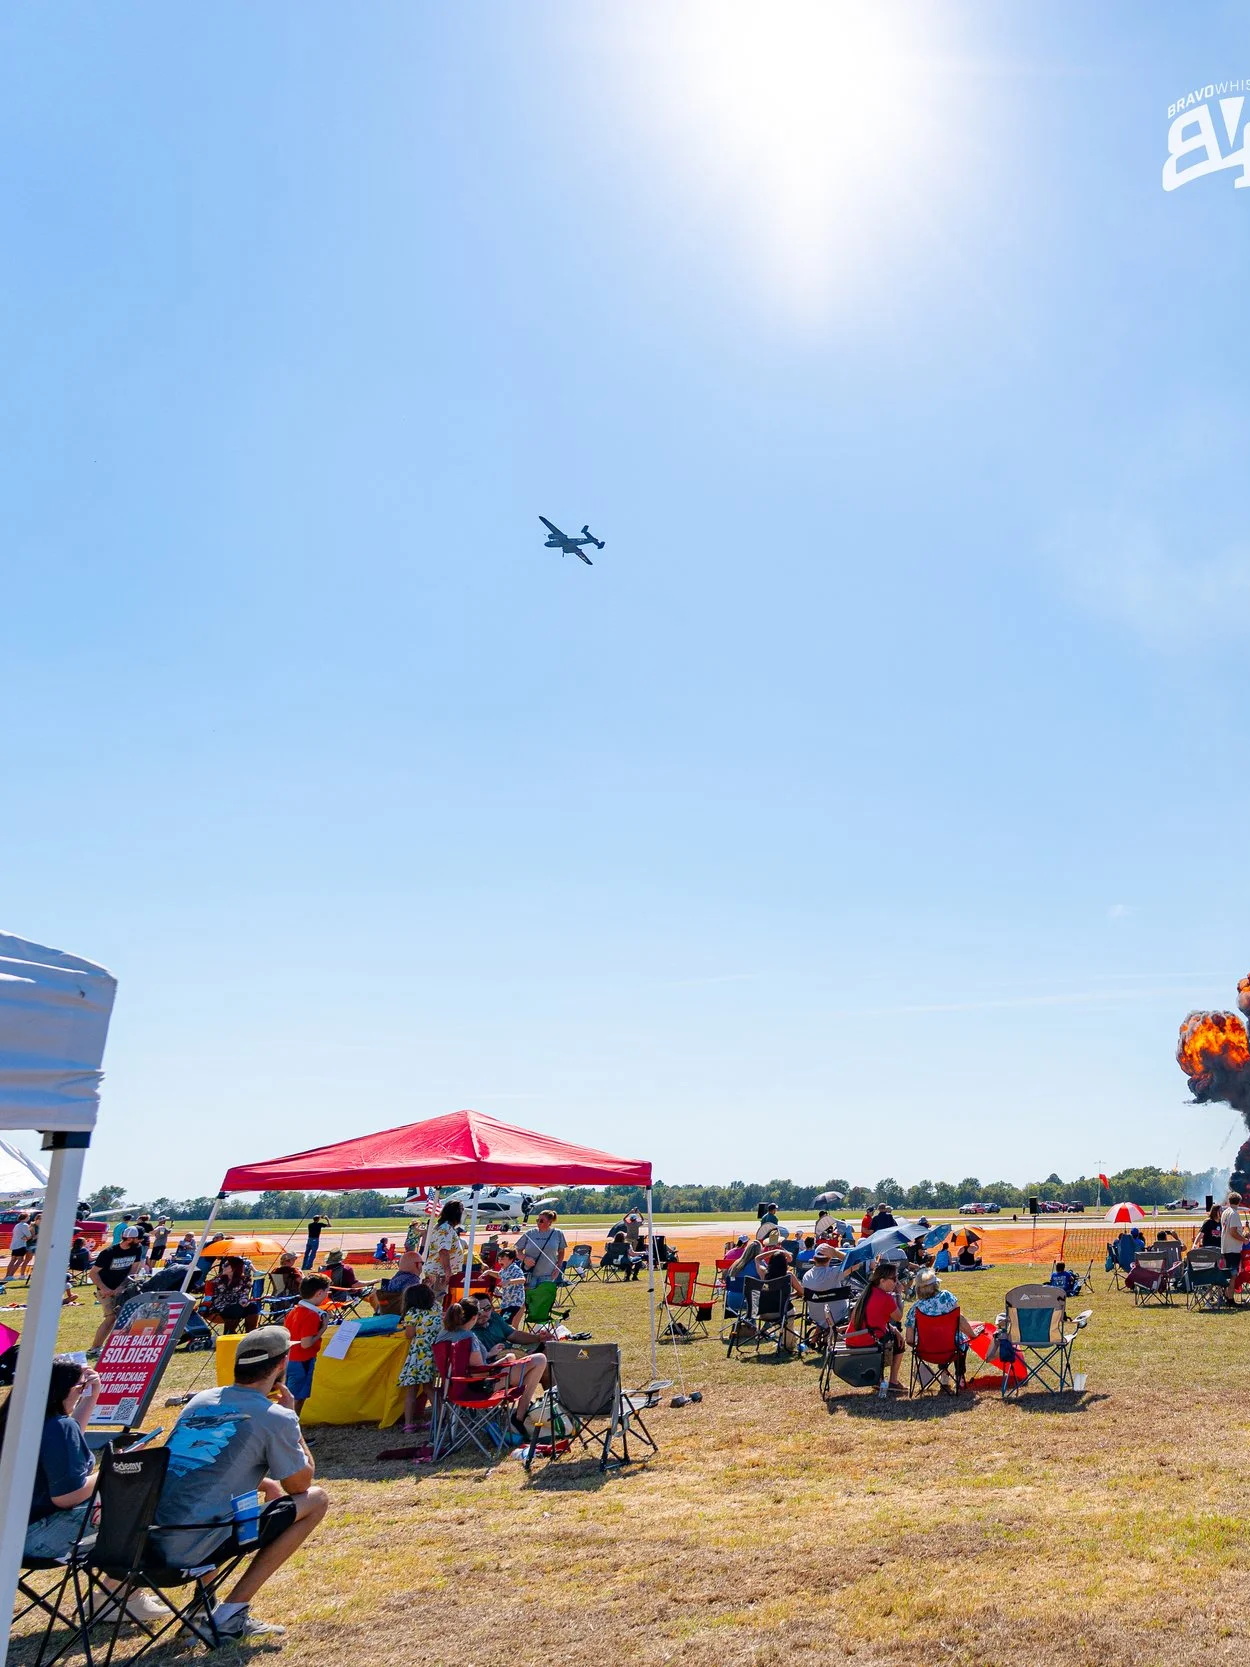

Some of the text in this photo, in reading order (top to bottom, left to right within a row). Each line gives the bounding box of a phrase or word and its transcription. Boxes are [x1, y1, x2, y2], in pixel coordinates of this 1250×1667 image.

[110, 1334, 167, 1347] GIVE BACK TO
[102, 1347, 162, 1363] SOLDIERS
[115, 1371, 148, 1382] PACKAGE
[108, 1383, 144, 1394] DROP-OFF
